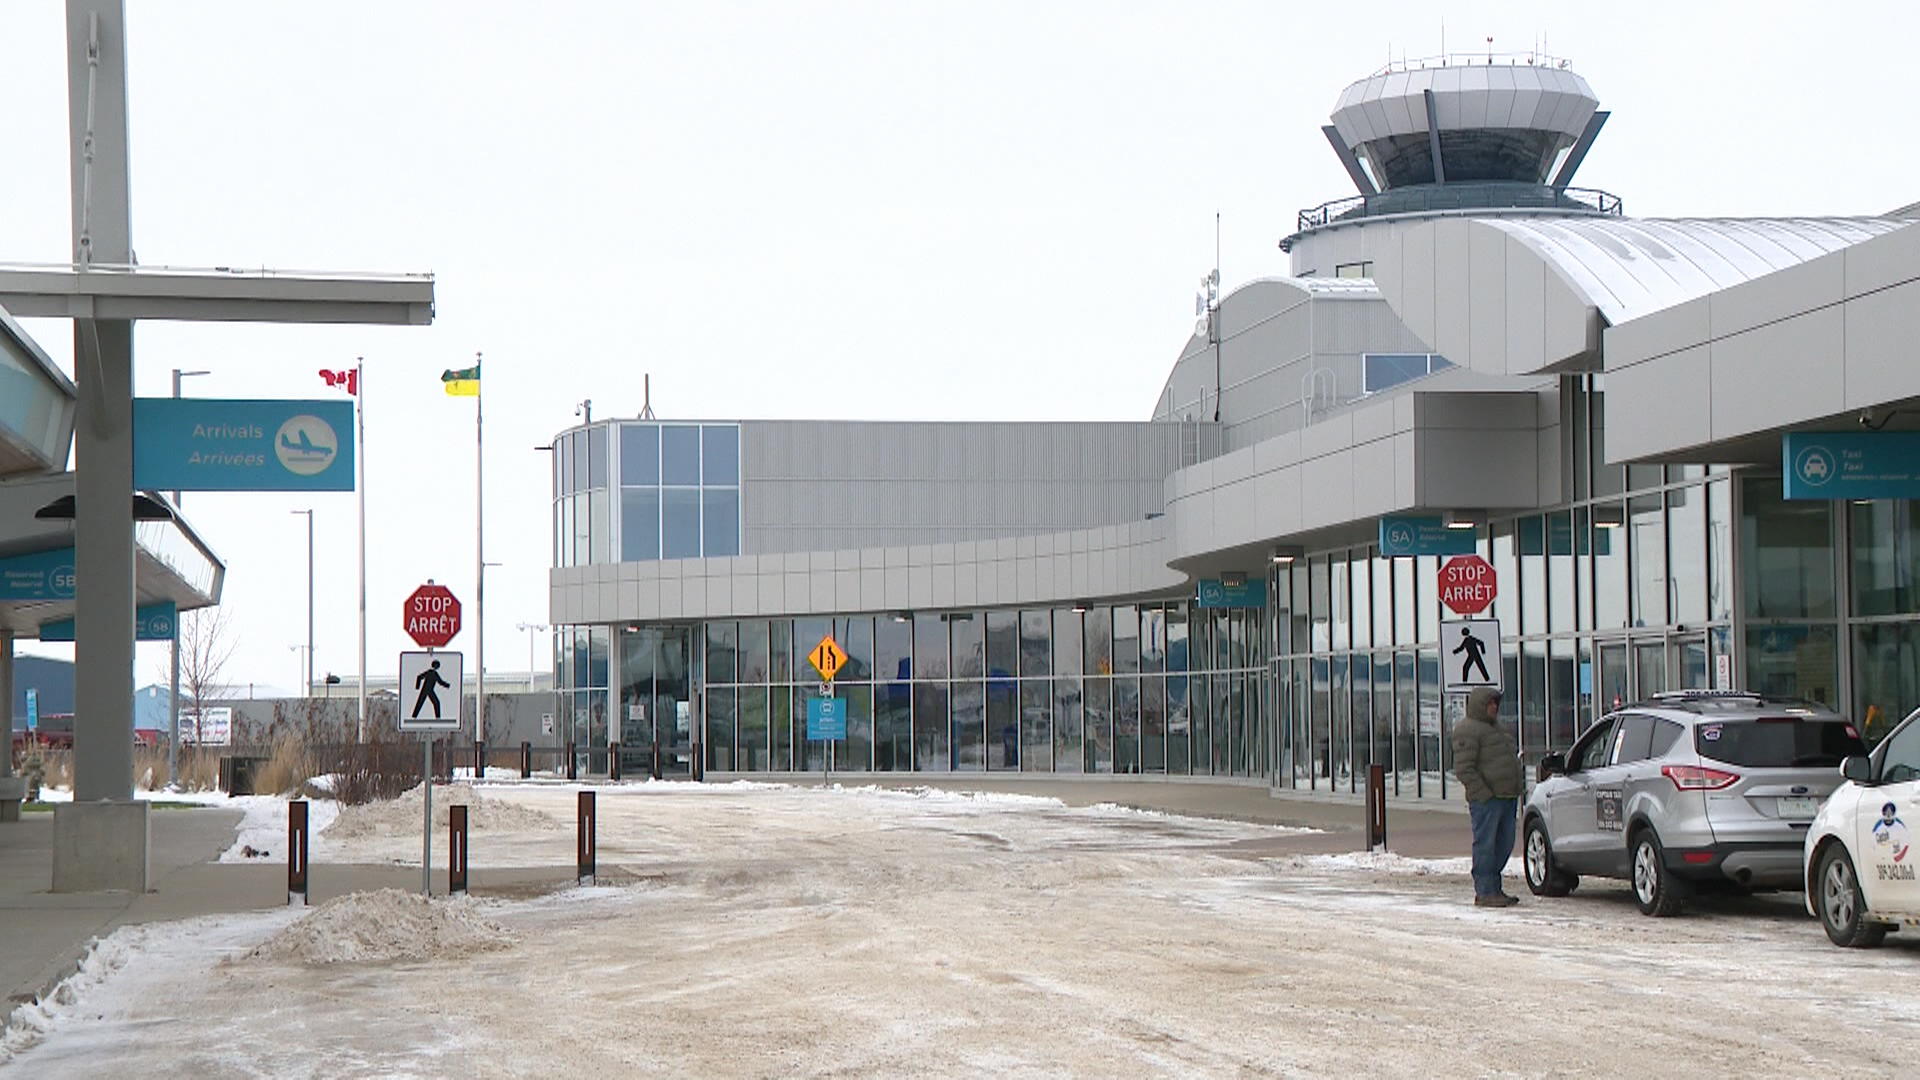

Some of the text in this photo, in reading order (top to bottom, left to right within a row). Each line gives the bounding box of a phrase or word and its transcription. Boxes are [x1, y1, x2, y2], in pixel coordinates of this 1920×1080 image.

[192, 423, 264, 439] Arrivals
[1841, 449, 1862, 459] Taxi
[1391, 529, 1410, 542] 5A
[55, 575, 76, 587] 5B
[1447, 565, 1487, 582] STOP
[1443, 582, 1493, 602] ARRÊT
[414, 596, 452, 613] STOP
[153, 621, 168, 632] 5B
[408, 613, 457, 634] ARRÊT
